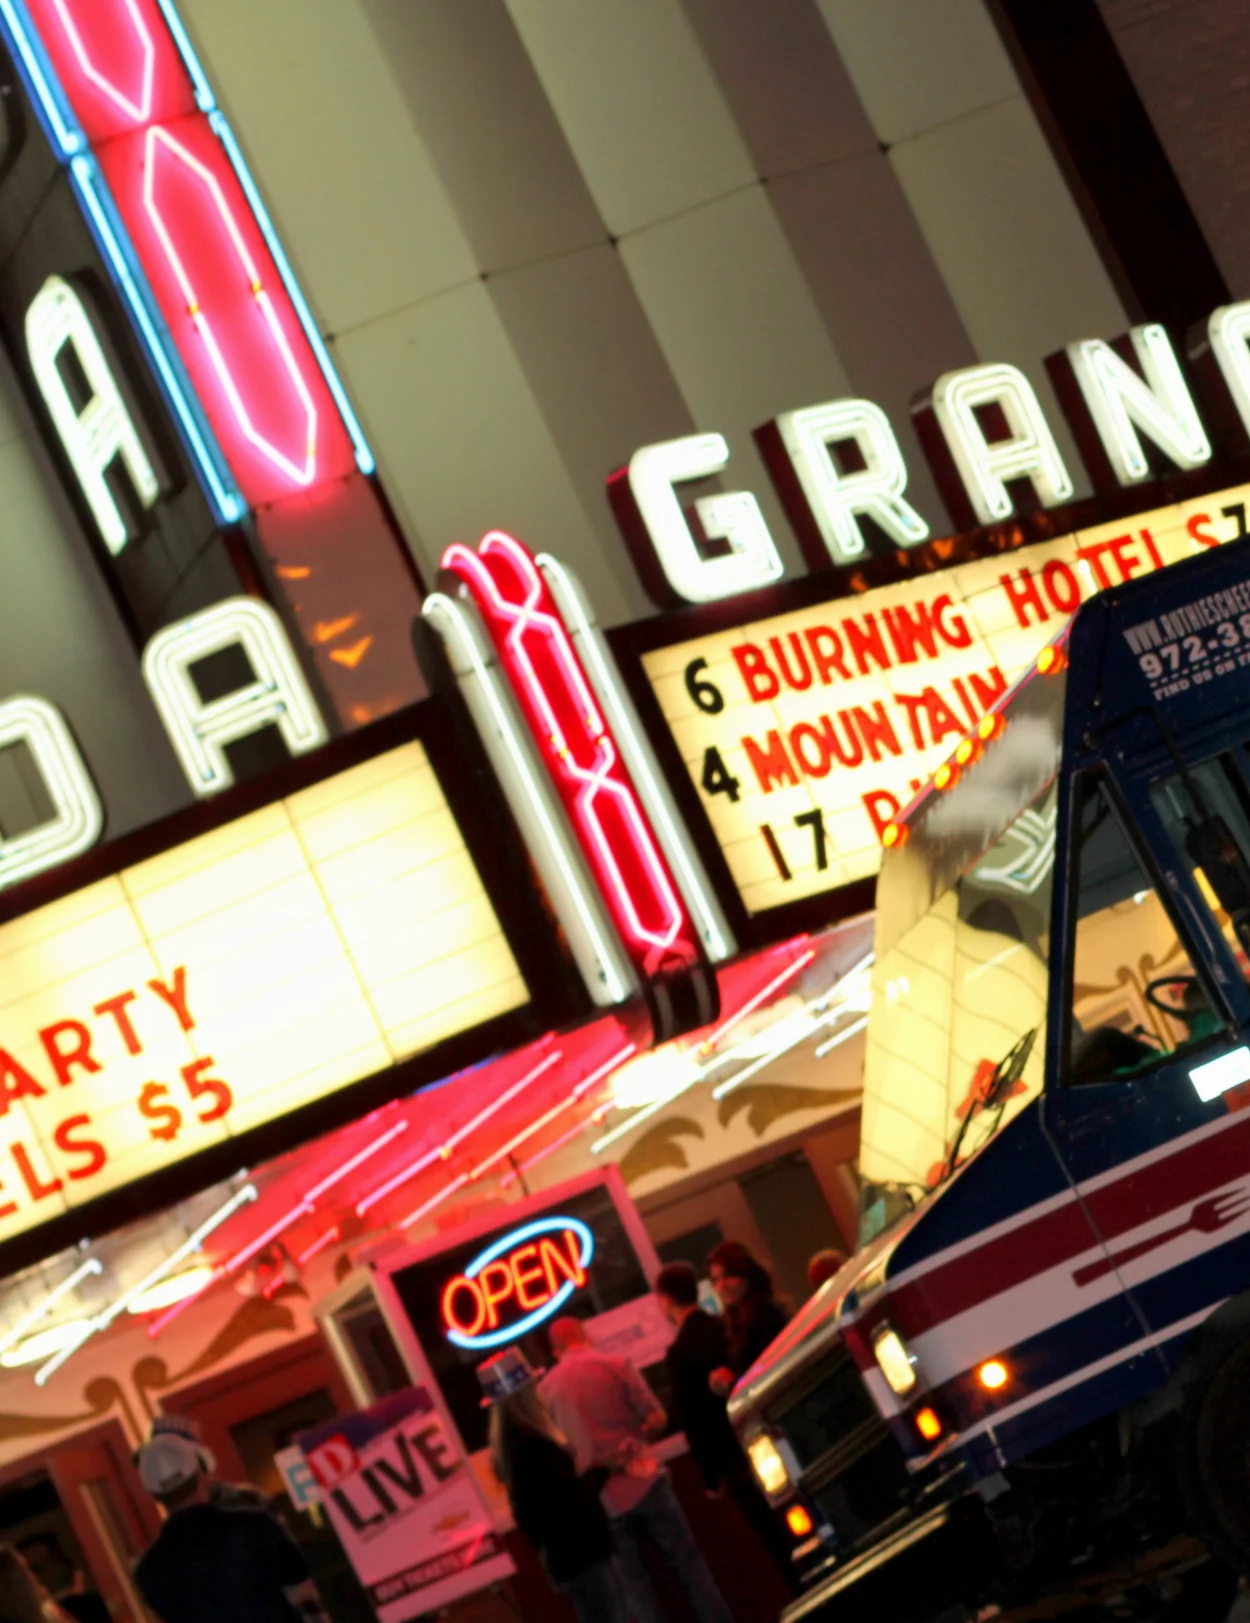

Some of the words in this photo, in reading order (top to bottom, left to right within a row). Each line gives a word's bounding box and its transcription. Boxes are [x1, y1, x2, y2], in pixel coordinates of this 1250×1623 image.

[26, 274, 158, 556] A
[684, 656, 725, 716] 6
[730, 593, 974, 703] BURNING
[1153, 679, 1190, 701] FIND
[1194, 668, 1213, 686] US
[1215, 660, 1236, 677] ON
[701, 746, 741, 803] 4
[740, 667, 1010, 794] MOUNTAIN
[759, 808, 828, 881] 17
[138, 1056, 233, 1142] $5
[441, 1229, 587, 1337] OPEN
[330, 1422, 466, 1534] LIVE
